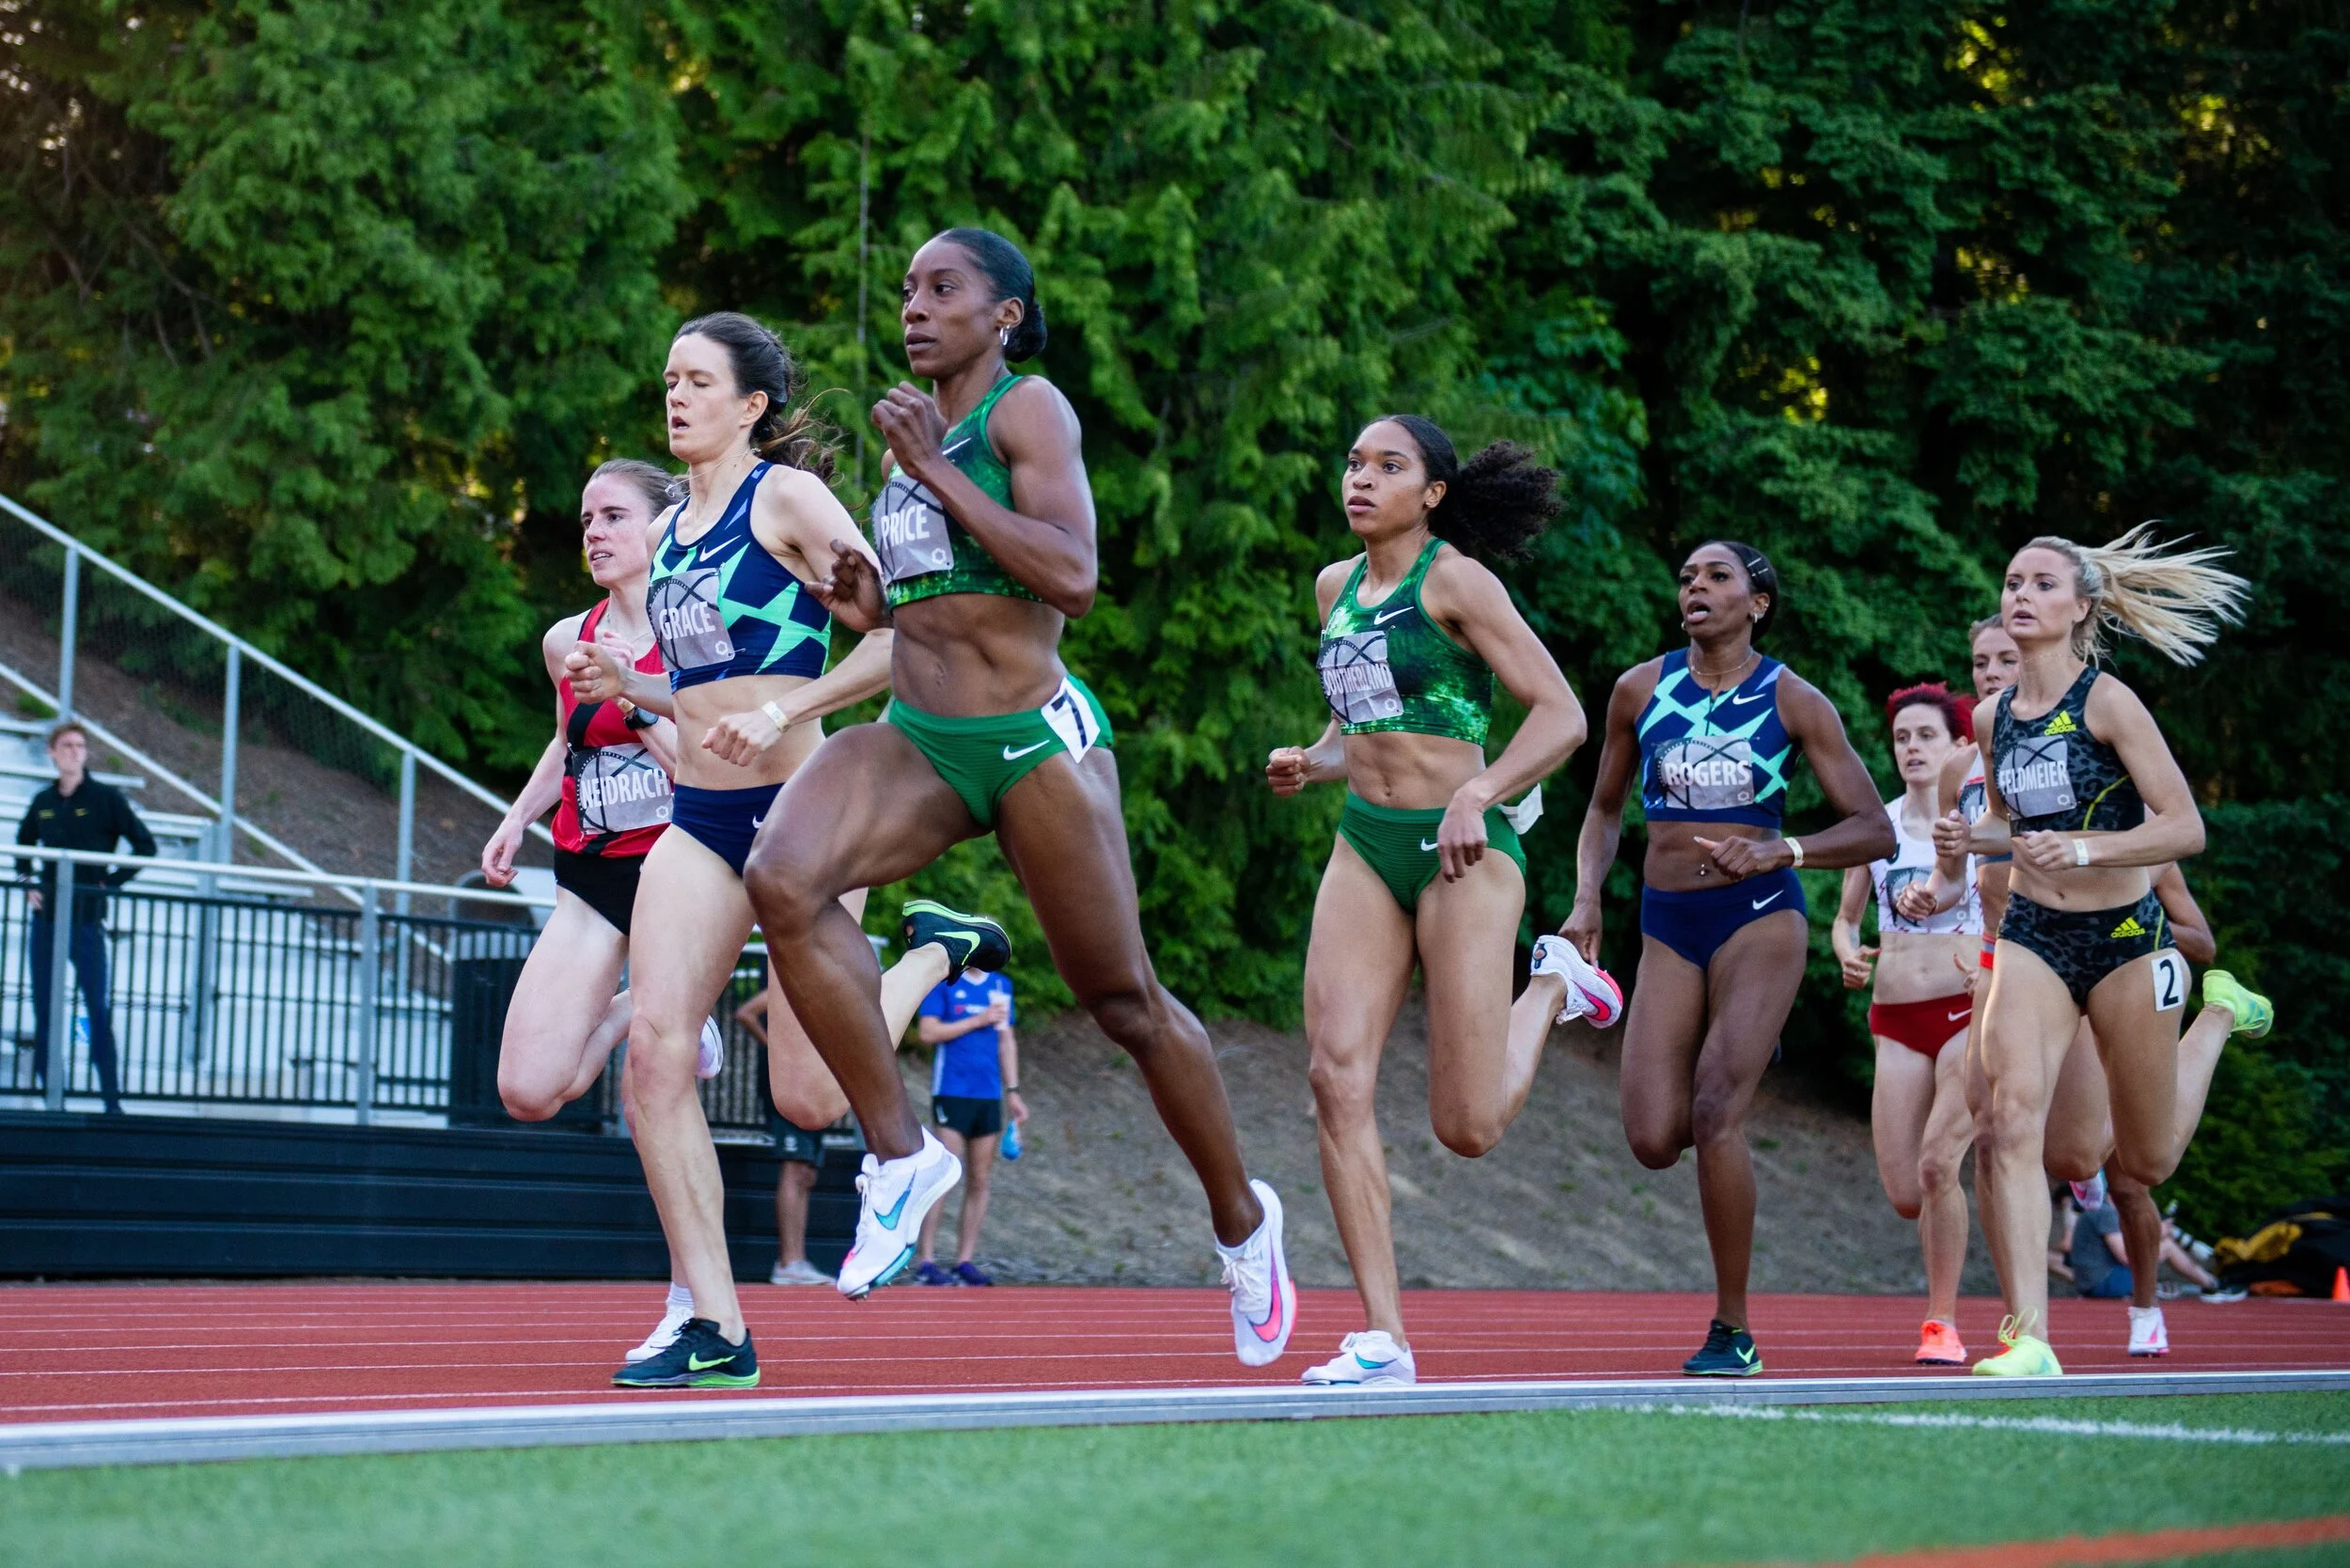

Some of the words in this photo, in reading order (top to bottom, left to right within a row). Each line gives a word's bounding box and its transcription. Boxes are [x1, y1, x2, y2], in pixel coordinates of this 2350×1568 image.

[881, 503, 930, 550] PRICE
[659, 602, 715, 640] GRACE
[1324, 664, 1393, 696] SOUTHERLAND
[580, 766, 671, 809] NEIDRACH
[1665, 760, 1751, 788] ROGERS
[1998, 760, 2070, 795] FELDMEIER
[2159, 958, 2179, 1007] 2
